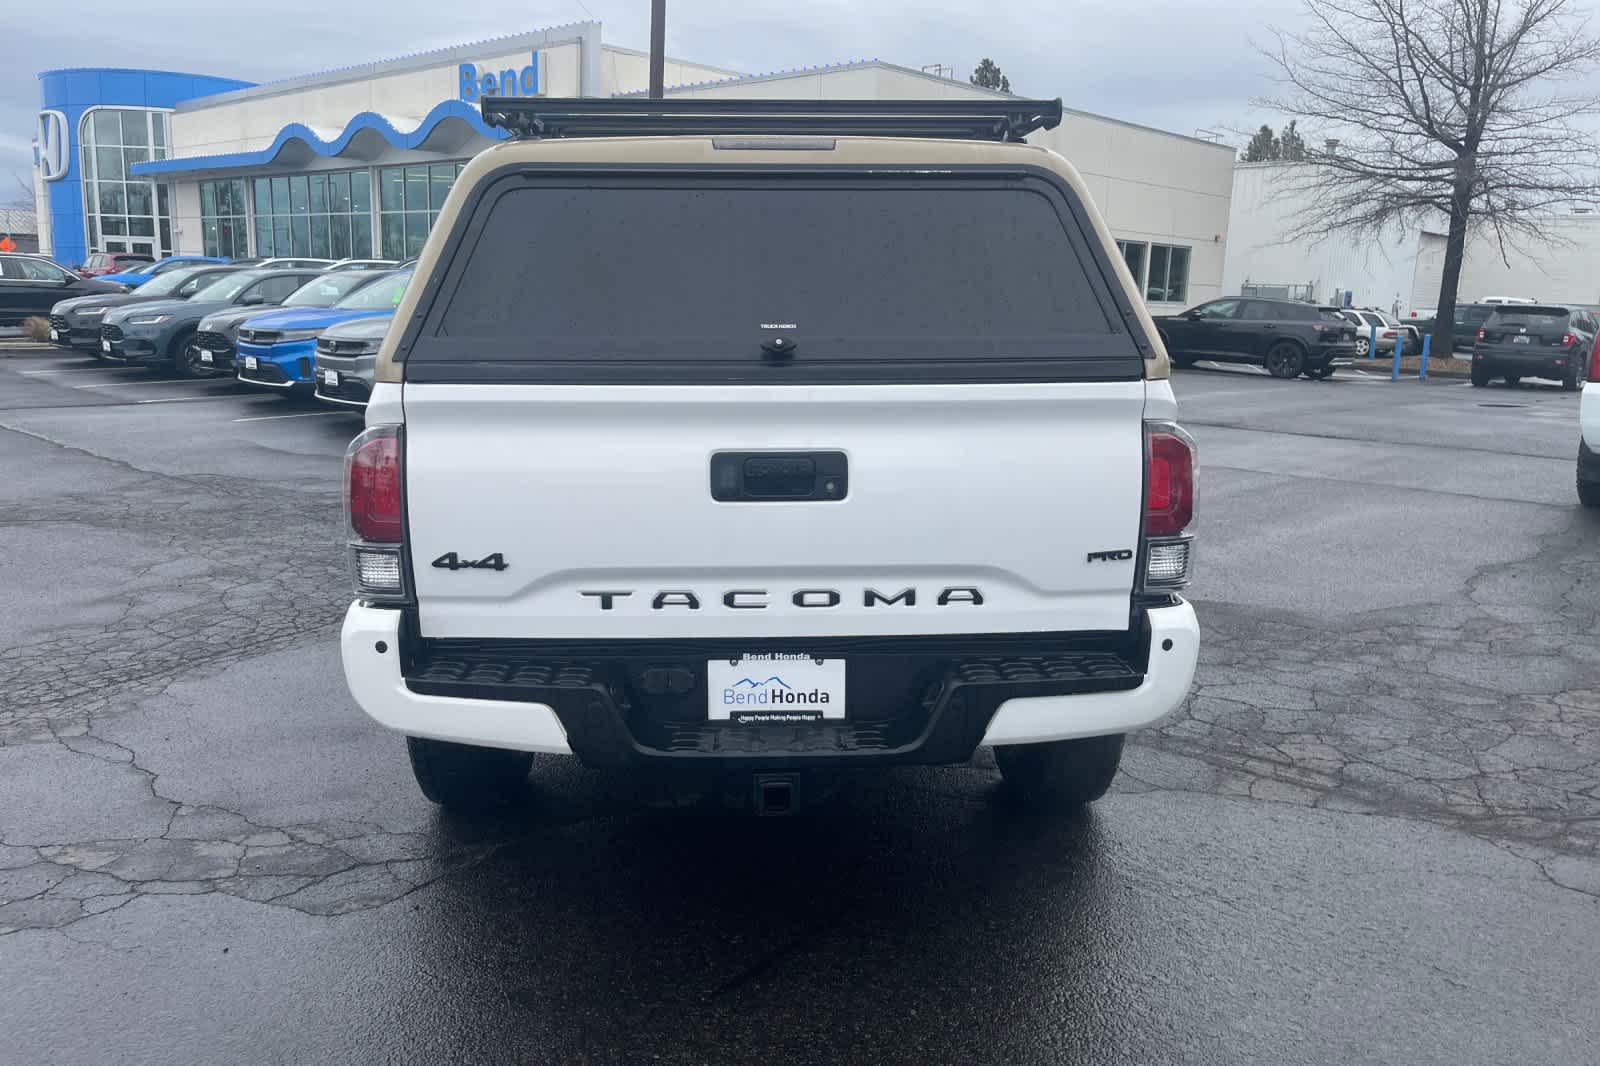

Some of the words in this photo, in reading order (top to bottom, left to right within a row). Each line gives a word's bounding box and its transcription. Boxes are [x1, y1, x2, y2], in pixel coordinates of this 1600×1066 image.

[459, 50, 538, 102] Bend
[432, 552, 509, 571] 4x4
[1087, 550, 1133, 562] PRO
[580, 587, 984, 610] TACOMA
[743, 653, 771, 661] Bend
[775, 652, 811, 661] Honda
[723, 689, 768, 704] Bend
[771, 689, 830, 704] Honda
